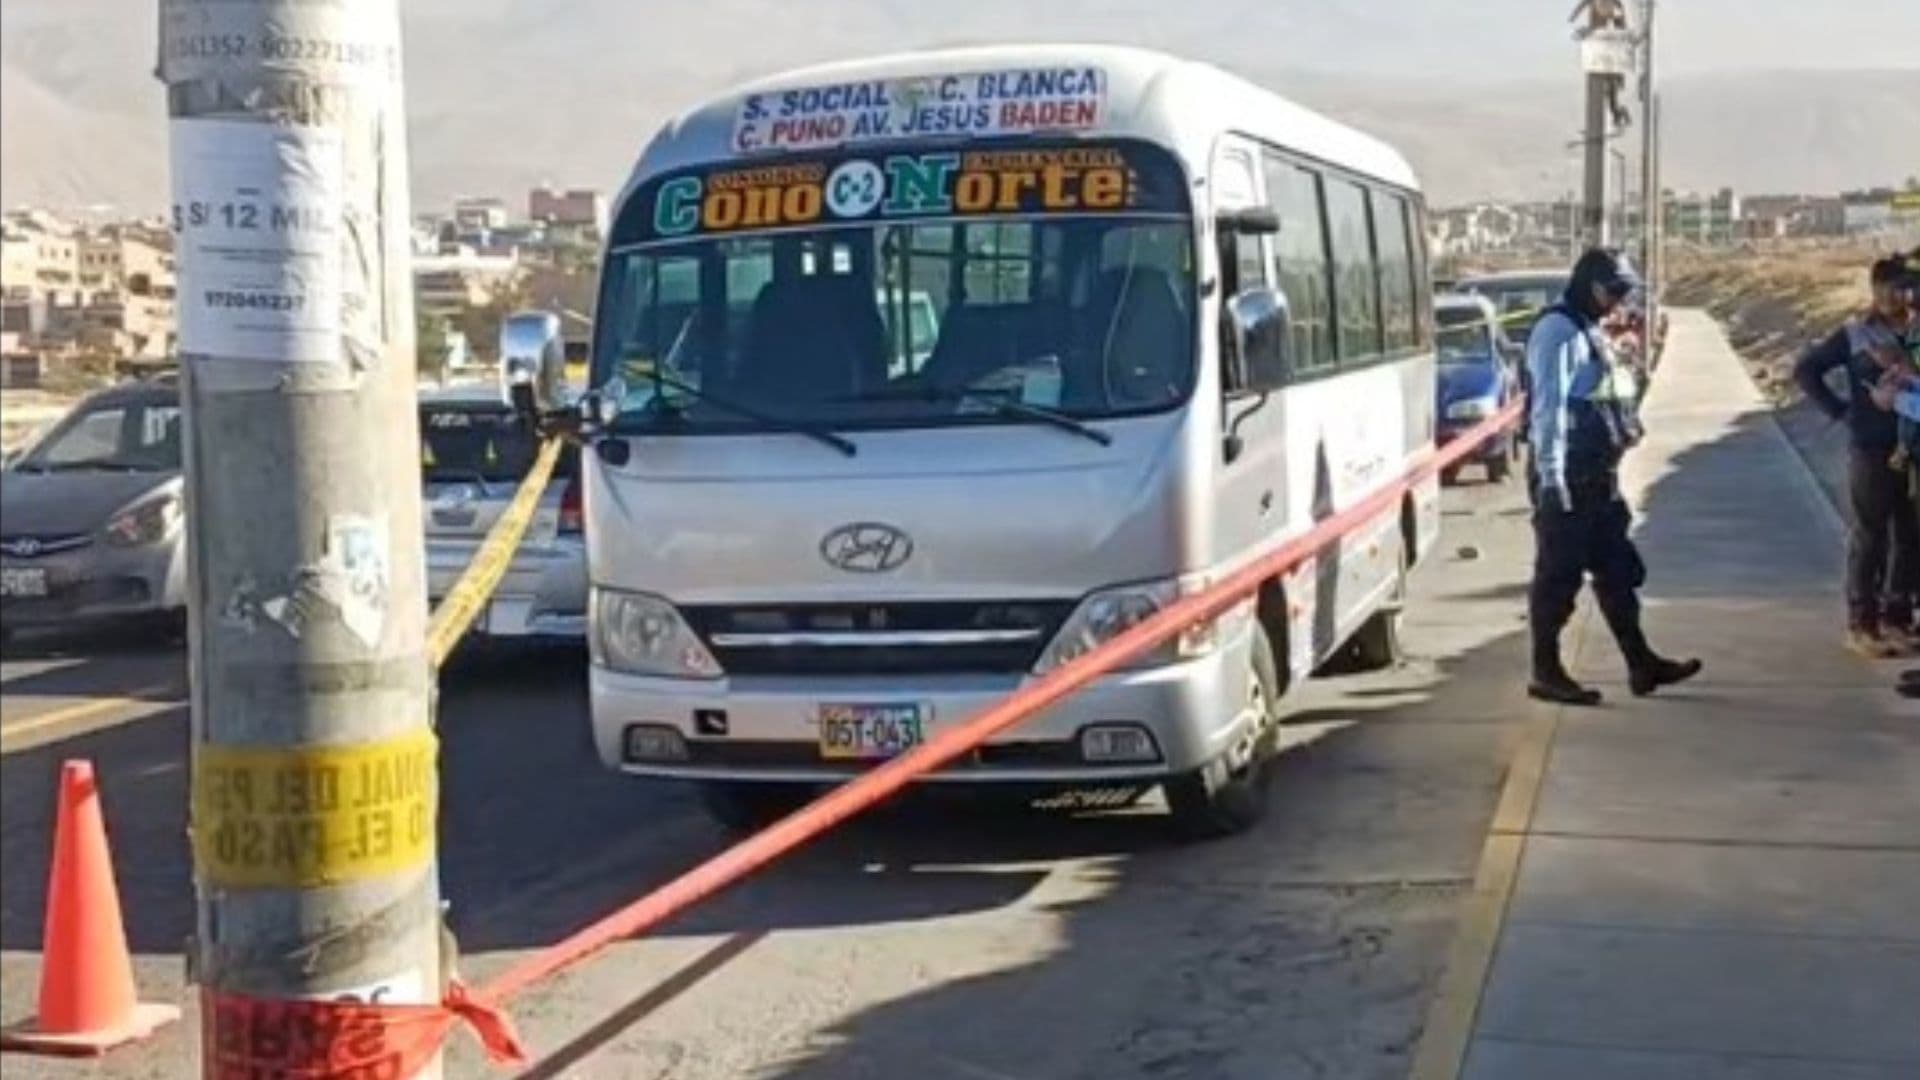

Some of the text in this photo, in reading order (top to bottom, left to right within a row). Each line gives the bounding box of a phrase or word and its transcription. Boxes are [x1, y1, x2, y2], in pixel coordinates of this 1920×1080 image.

[743, 69, 1098, 121] S. SOCIAL C. BLANCA
[737, 101, 1097, 149] C. PUNO AV. JESUS BADEN
[221, 203, 259, 229] 12
[272, 207, 334, 233] MIL
[654, 176, 824, 236] Cono
[881, 153, 1126, 215] Norte
